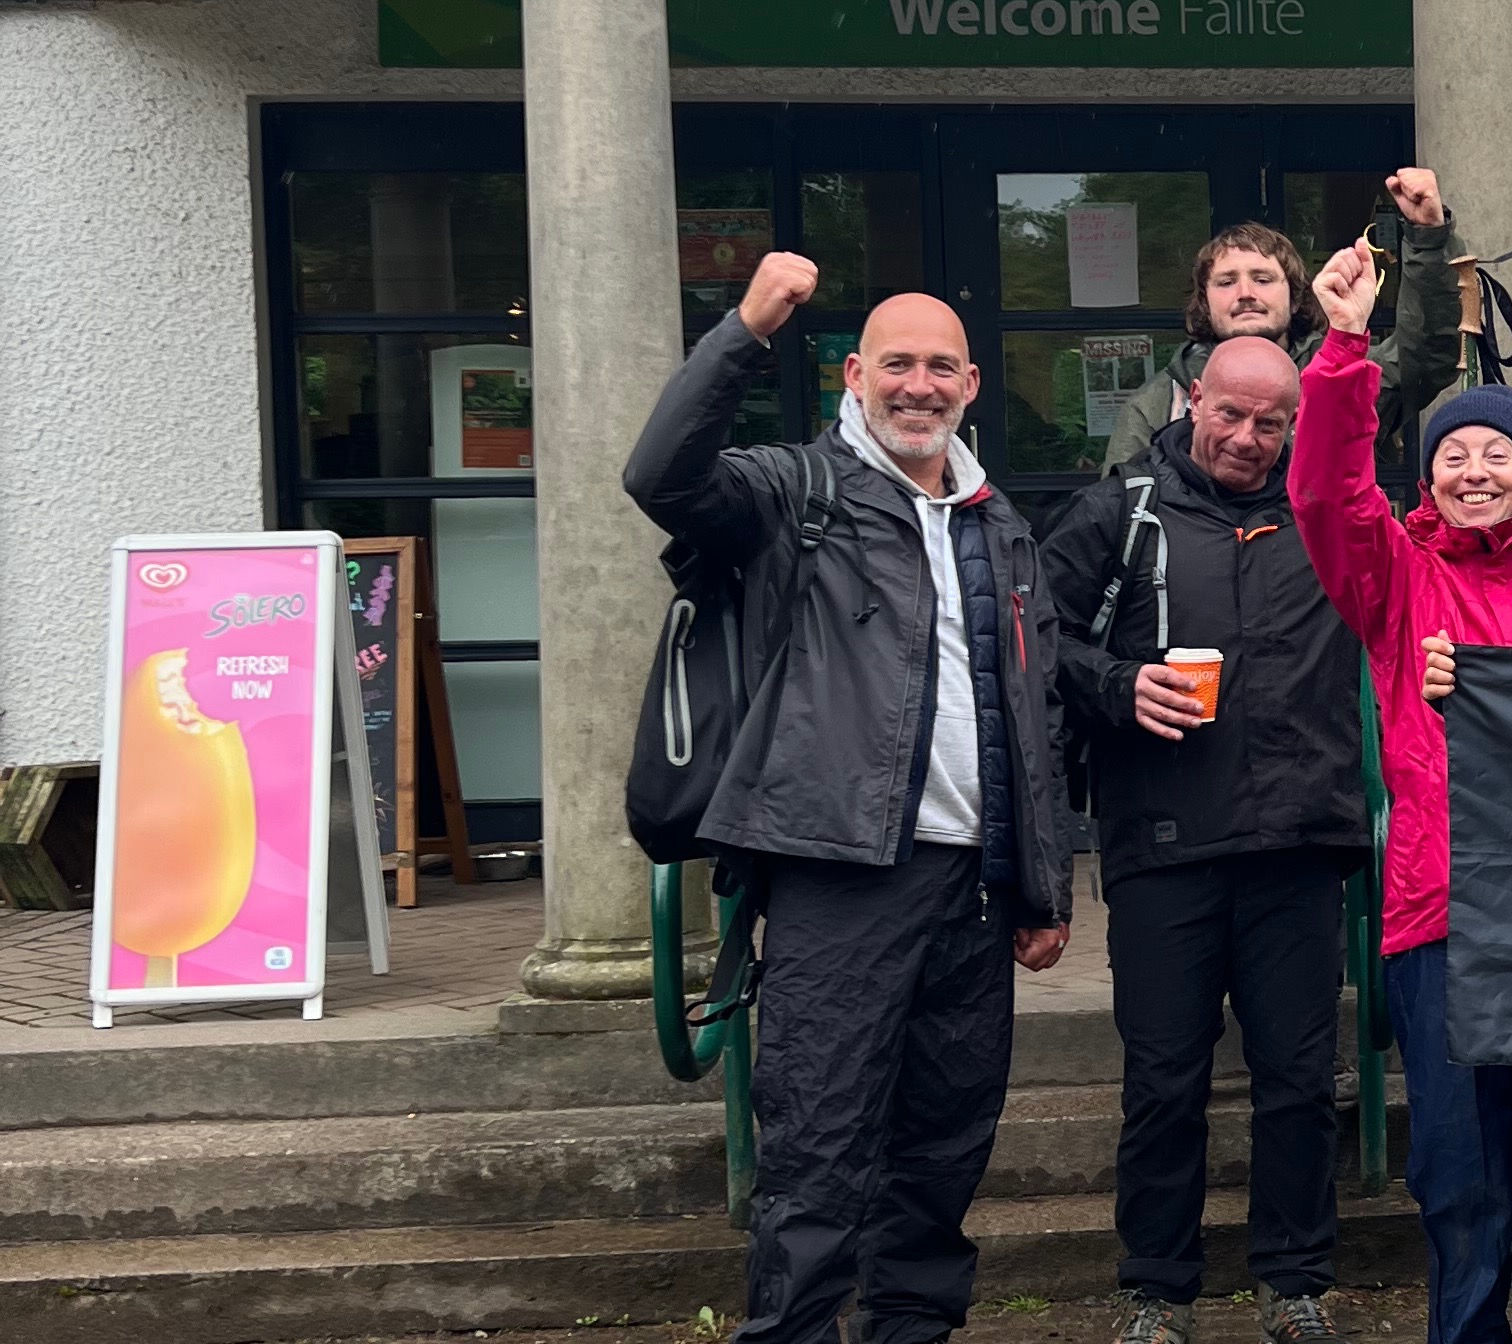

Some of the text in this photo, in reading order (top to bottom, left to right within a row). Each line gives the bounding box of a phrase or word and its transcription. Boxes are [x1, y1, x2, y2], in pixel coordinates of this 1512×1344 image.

[1083, 342, 1150, 357] MISSING
[203, 593, 305, 638] SOLERO
[216, 655, 289, 677] REFRESH
[231, 679, 273, 700] NOW
